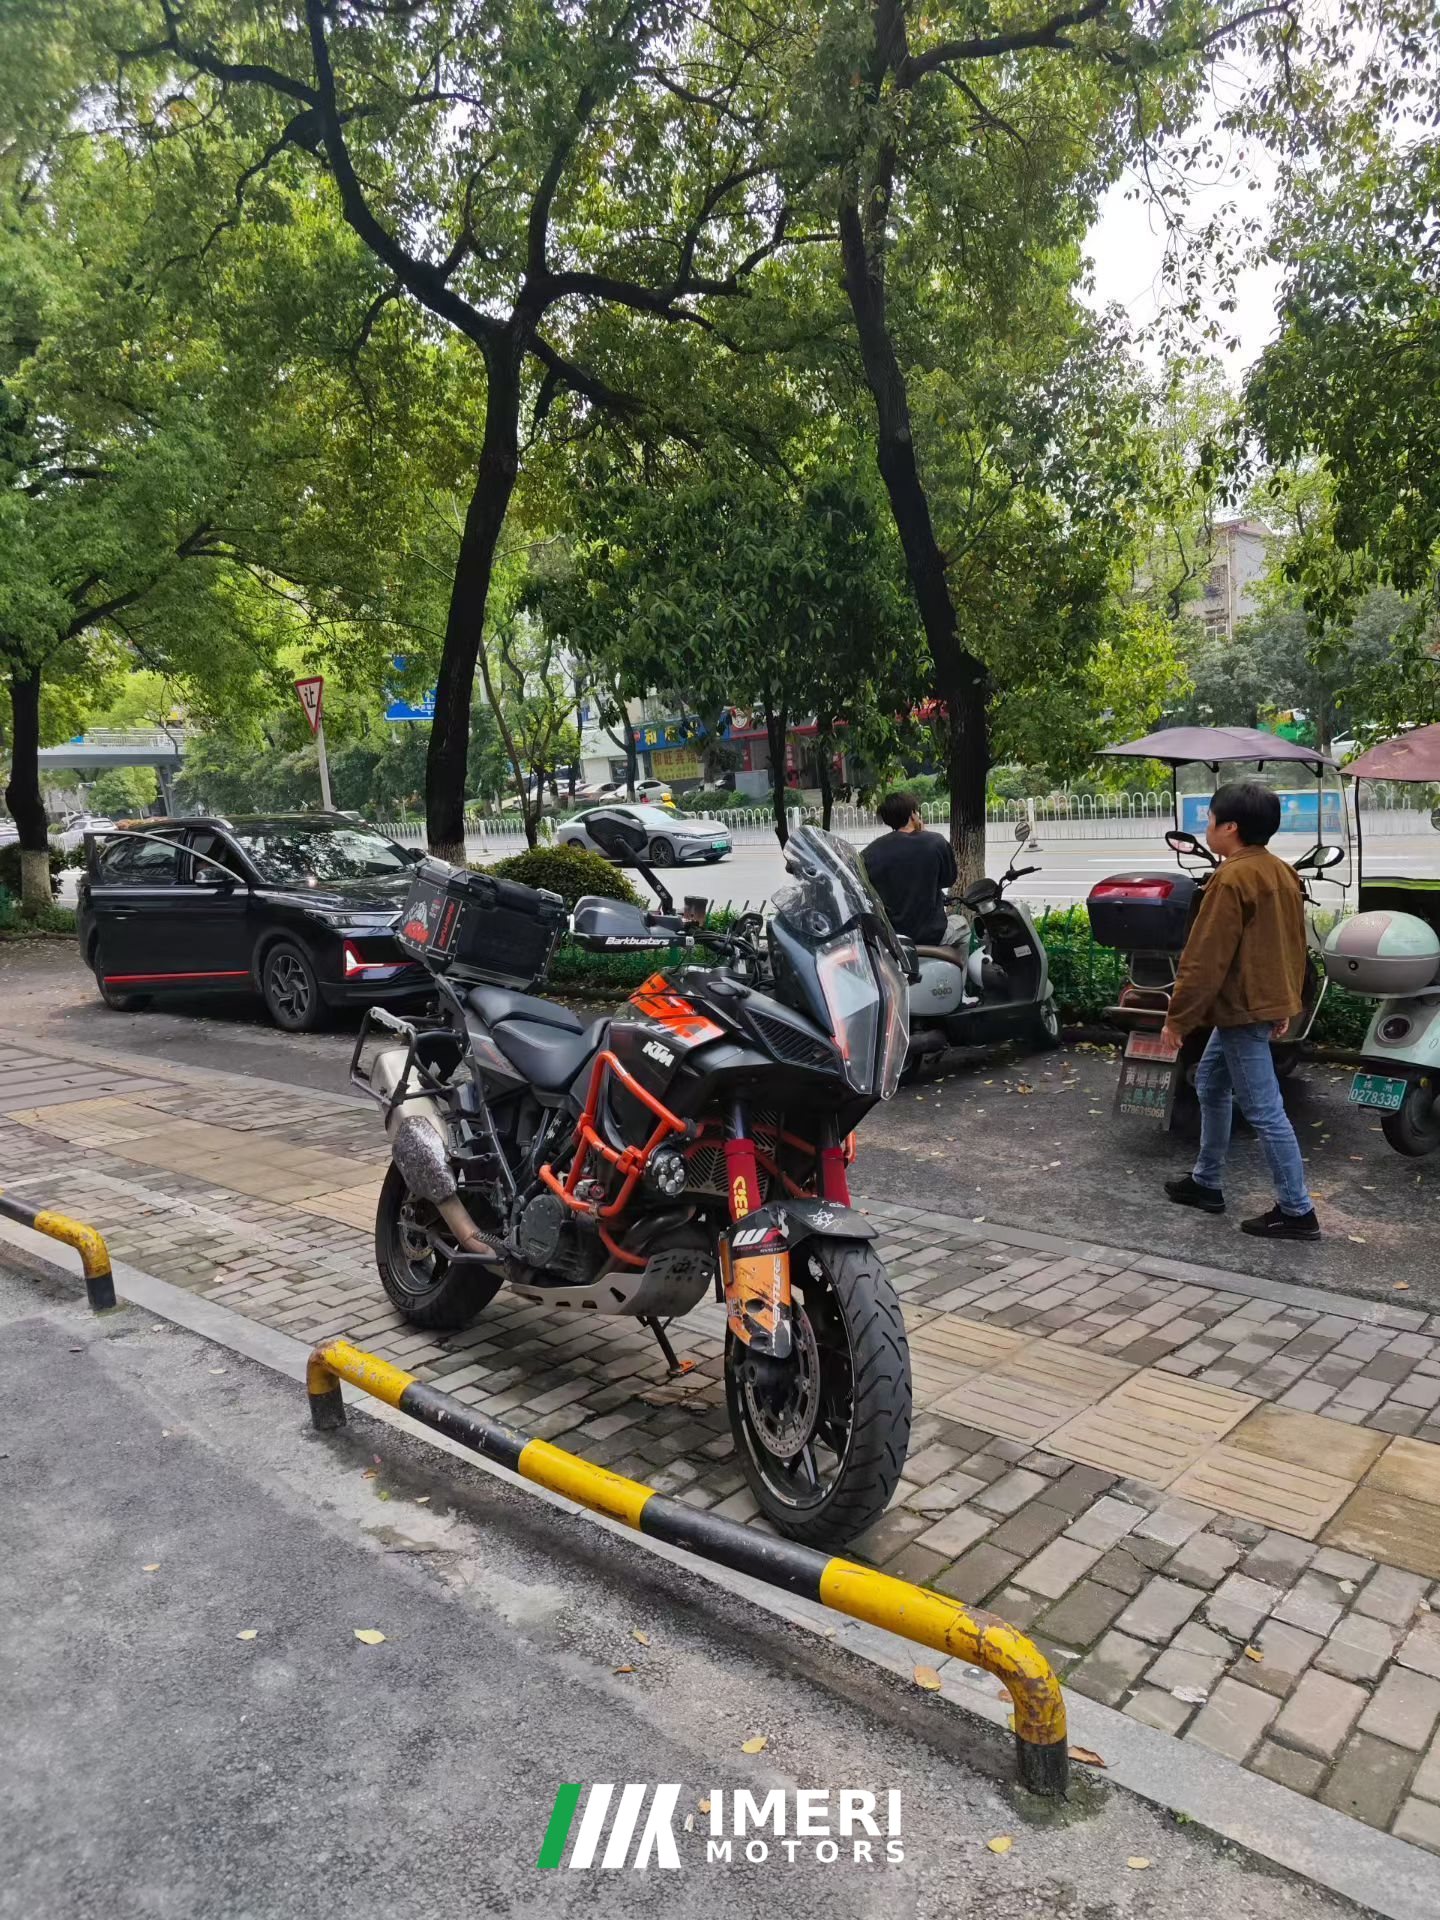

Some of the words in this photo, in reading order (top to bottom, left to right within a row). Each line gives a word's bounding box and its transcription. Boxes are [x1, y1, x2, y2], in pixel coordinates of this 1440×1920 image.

[304, 685, 316, 709] 让
[605, 936, 669, 946] Barkbusters
[642, 1041, 675, 1067] KTM
[1350, 1088, 1400, 1107] 0278338
